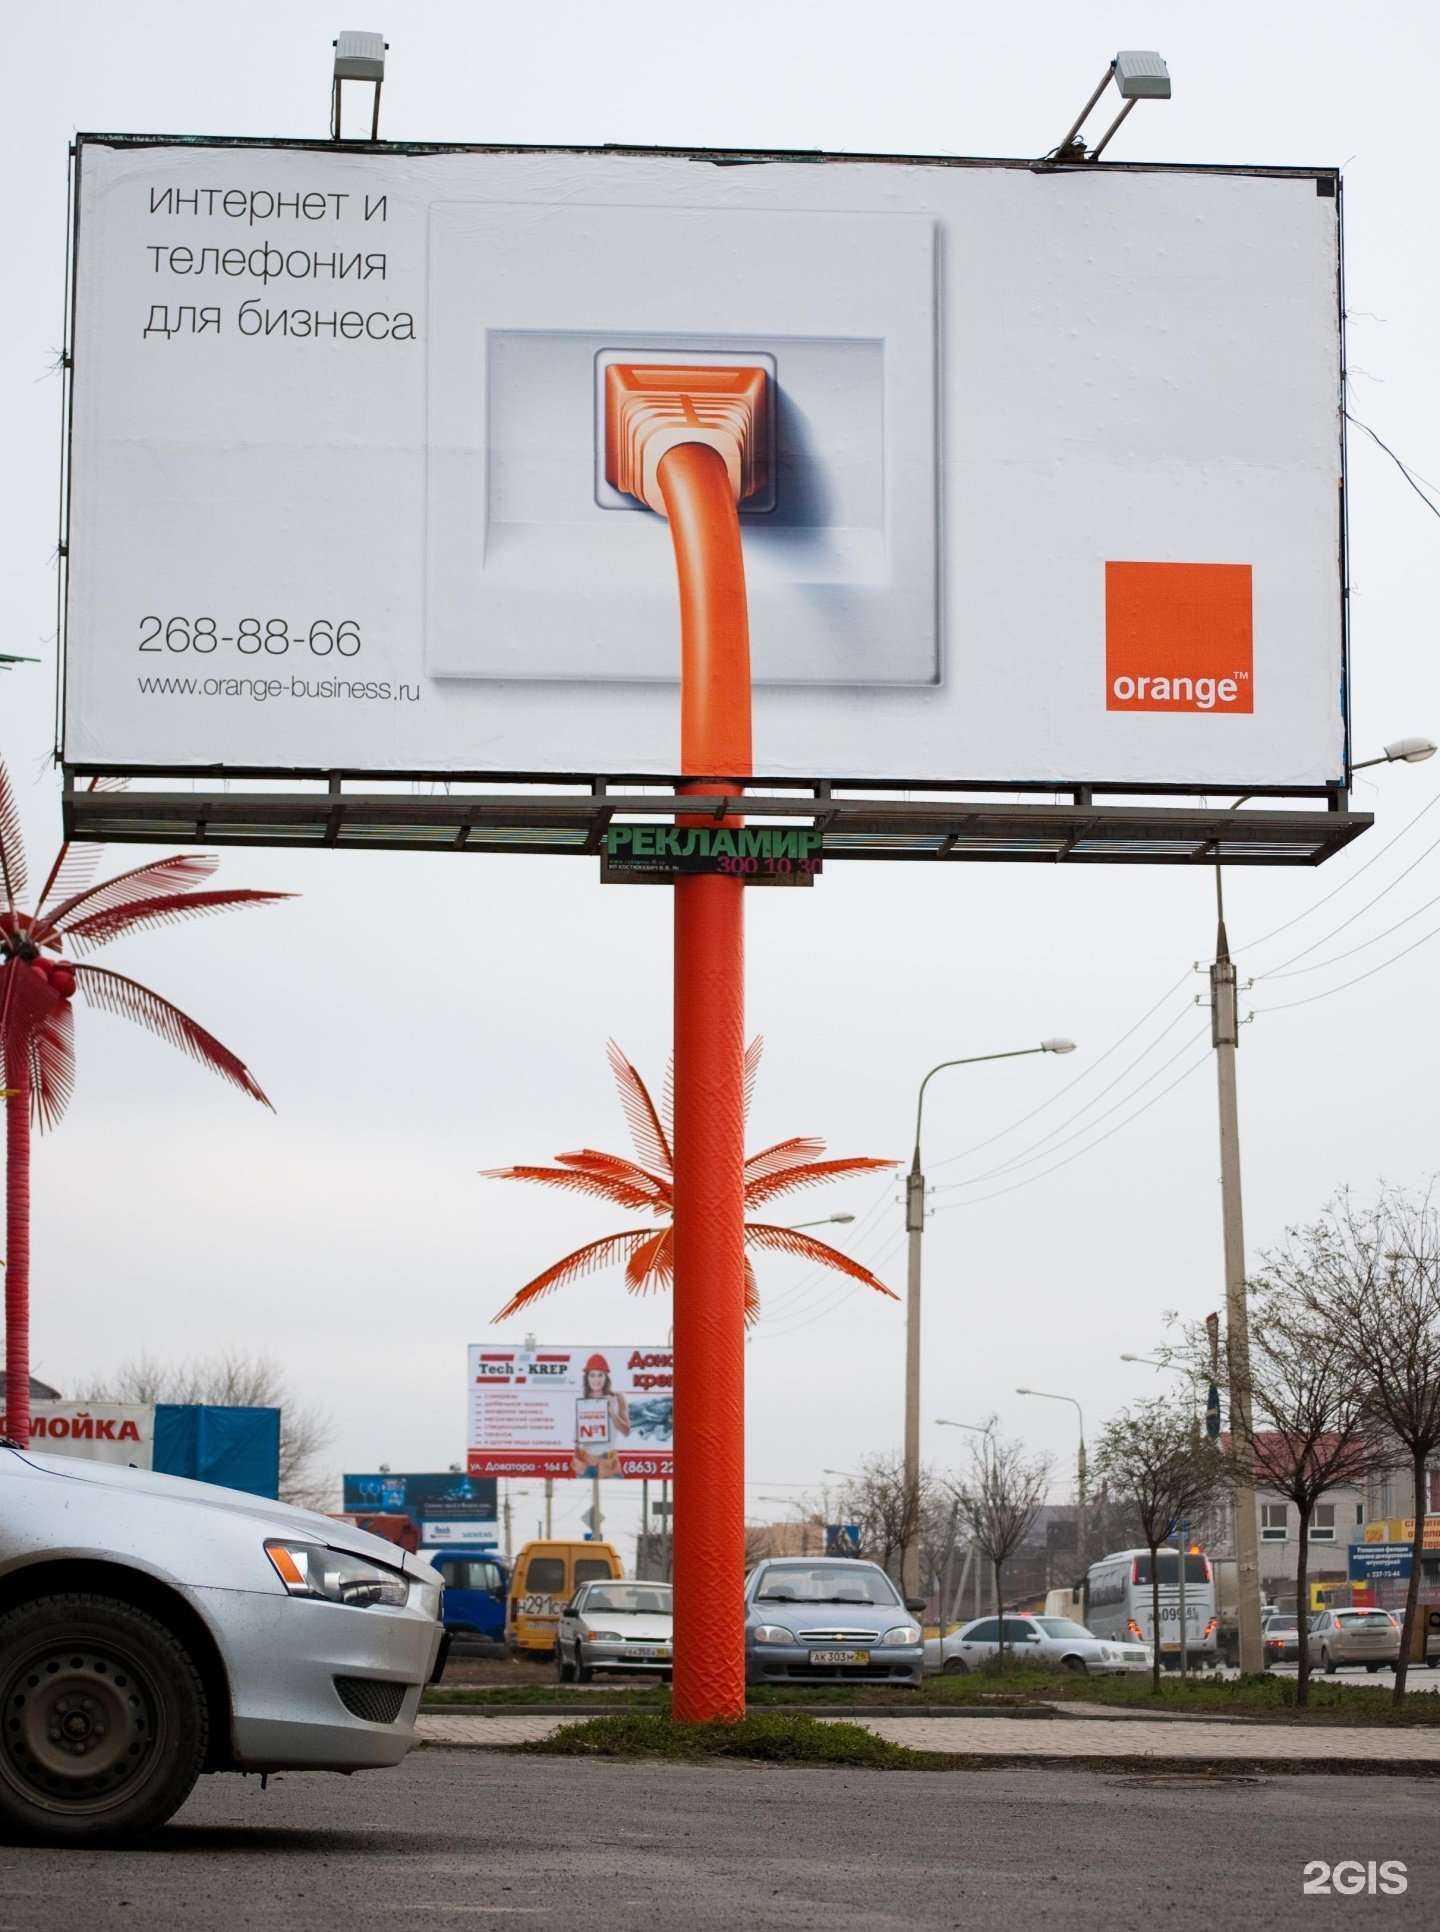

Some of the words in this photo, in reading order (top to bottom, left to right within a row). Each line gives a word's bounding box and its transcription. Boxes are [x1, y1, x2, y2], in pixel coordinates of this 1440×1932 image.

[148, 186, 350, 226] интернет
[364, 193, 387, 222] и
[146, 241, 388, 286] телефония
[143, 303, 222, 340] для
[237, 299, 417, 341] бизнеса
[138, 615, 362, 657] 268-88-66
[137, 674, 421, 702] www.orange-business.ru
[1113, 675, 1238, 709] orange
[607, 826, 823, 859] РЕКЛАМИР
[716, 856, 758, 873] 300
[764, 857, 792, 873] 10
[478, 1362, 514, 1375] Tech
[527, 1363, 568, 1375] KREP
[623, 1460, 657, 1475] (863)
